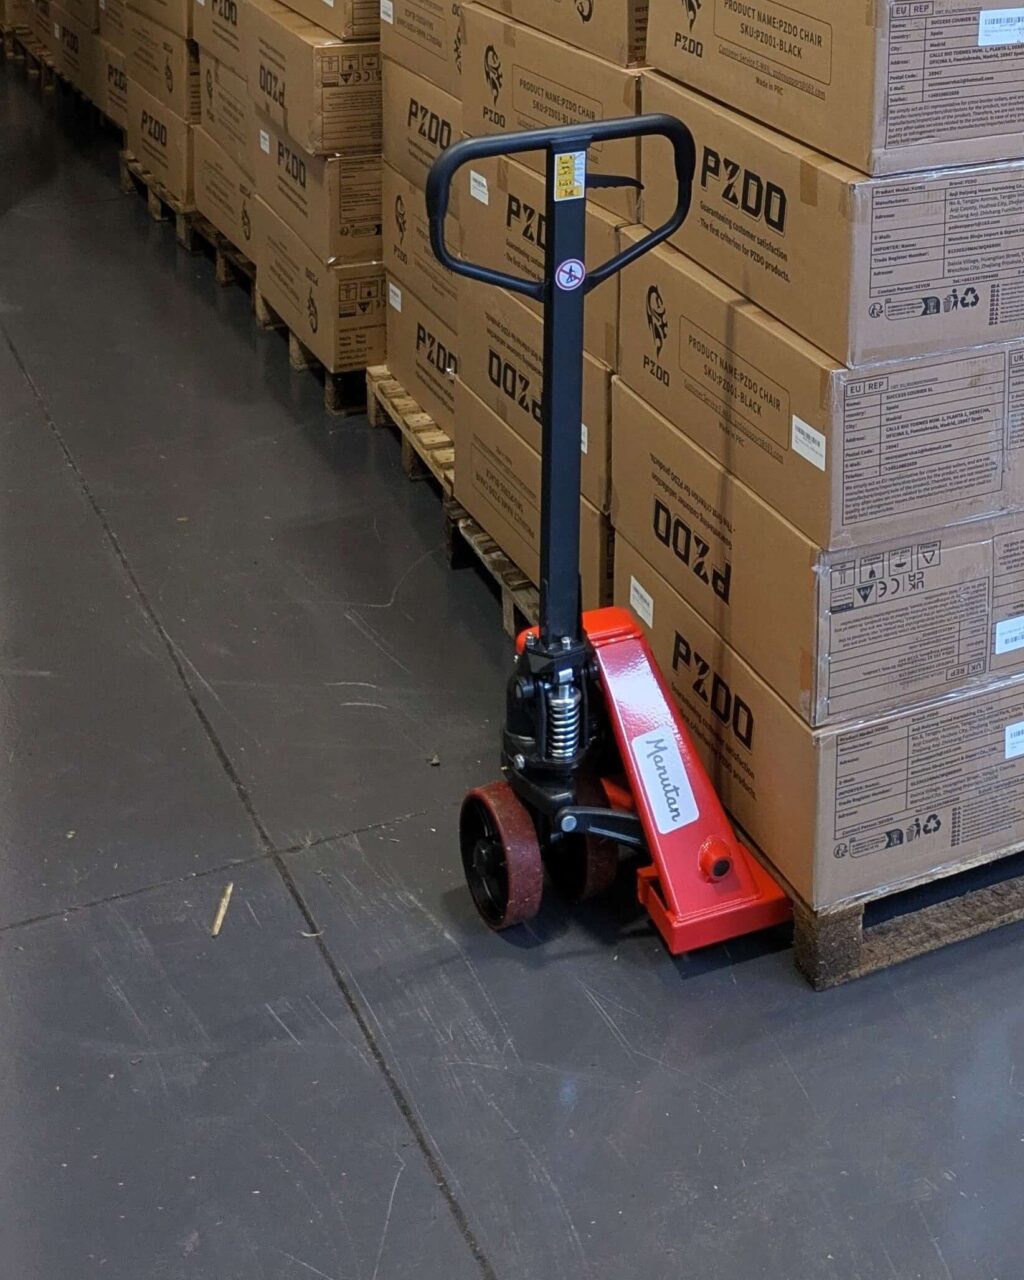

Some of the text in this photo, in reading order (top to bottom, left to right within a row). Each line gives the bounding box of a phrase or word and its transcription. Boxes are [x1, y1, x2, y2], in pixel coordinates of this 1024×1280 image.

[758, 10, 797, 37] NAME:PZDO
[800, 28, 822, 47] CHAIR
[896, 5, 929, 15] EU REP
[674, 32, 703, 57] PZDO
[740, 23, 802, 59] SKU:PZ001-BLACK
[259, 64, 285, 109] PZDO
[520, 78, 595, 120] PRODUCT NAME:PZDO CHAIR
[756, 77, 767, 88] Made
[774, 84, 784, 95] PRC
[141, 109, 167, 148] PZDO
[408, 97, 451, 150] PZDO
[483, 106, 505, 128] PZDO
[277, 141, 306, 189] PZDO
[701, 146, 787, 237] PZDO
[700, 201, 787, 262] Guaranteeing customer satisfaction
[710, 224, 719, 238] first
[720, 230, 740, 252] criterion
[750, 250, 764, 266] PZDO
[643, 355, 670, 387] PZDO
[689, 335, 780, 412] PRODUCT NAME:PZDO CHAIR
[704, 365, 761, 417] SKU:PZ001-BLACK
[850, 379, 883, 394] EU REP
[654, 497, 732, 607] PZDO
[672, 630, 754, 755] PZDO
[646, 738, 681, 822] Manutan
